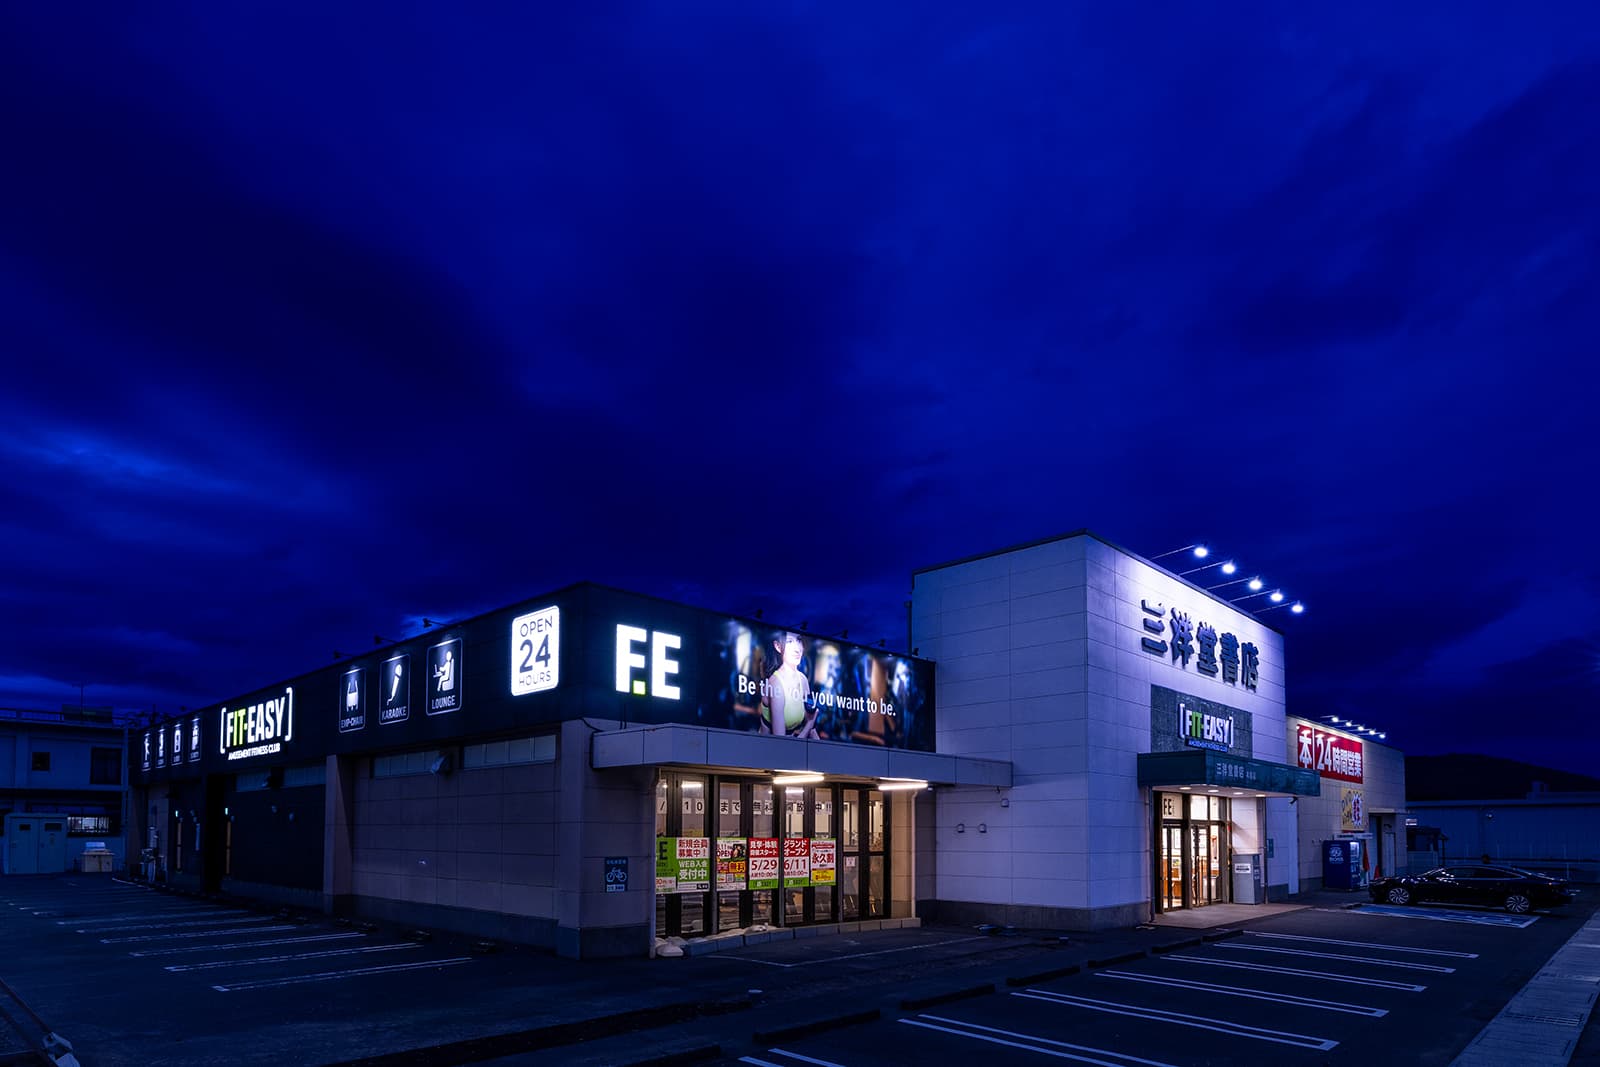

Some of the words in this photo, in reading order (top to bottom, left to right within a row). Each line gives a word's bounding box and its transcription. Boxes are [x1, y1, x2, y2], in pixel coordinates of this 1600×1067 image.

[520, 616, 552, 638] OPEN
[1141, 599, 1259, 692] 三洋堂書店
[519, 633, 551, 673] 24
[519, 670, 551, 687] HOURS
[431, 695, 456, 710] LOUNGE
[738, 675, 756, 695] Be
[759, 678, 781, 698] the
[811, 690, 833, 709] you
[836, 695, 864, 713] want
[866, 697, 877, 713] to
[880, 698, 897, 717] be.
[381, 706, 407, 721] KARAOKE
[268, 742, 280, 753] CLUB
[1299, 729, 1312, 769] 本
[1315, 734, 1361, 777] 24時間営業
[678, 839, 708, 849] 新規会員
[784, 839, 807, 849] グランド
[678, 848, 706, 858] 募集中!
[784, 848, 807, 857] オープン
[678, 860, 707, 868] WEB入会
[751, 859, 778, 871] 5/29
[784, 858, 806, 871] 6/11
[679, 868, 707, 880] 受付中
